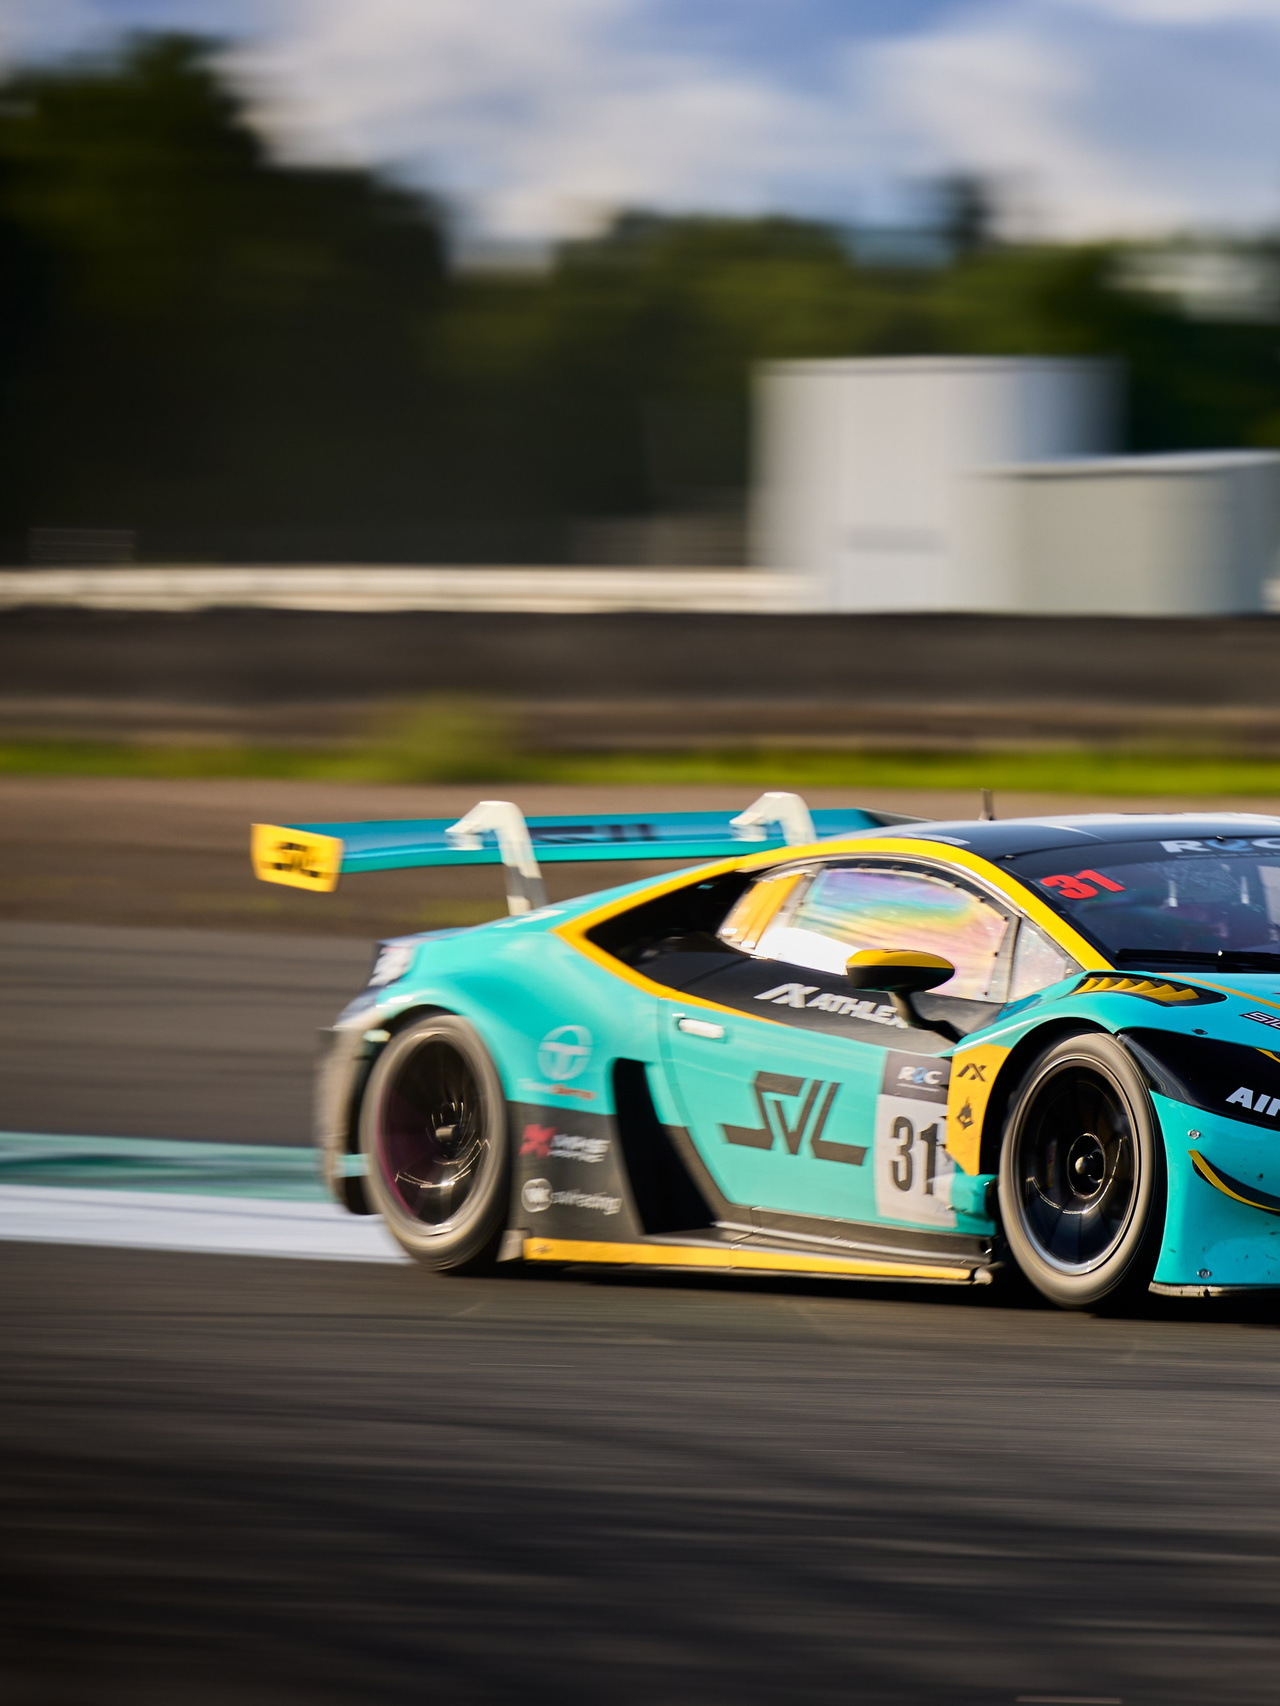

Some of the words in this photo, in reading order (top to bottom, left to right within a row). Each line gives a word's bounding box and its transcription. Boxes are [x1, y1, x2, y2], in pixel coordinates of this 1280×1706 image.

[1040, 869, 1125, 899] 31
[717, 1070, 869, 1166] SVL
[889, 1115, 938, 1196] 31
